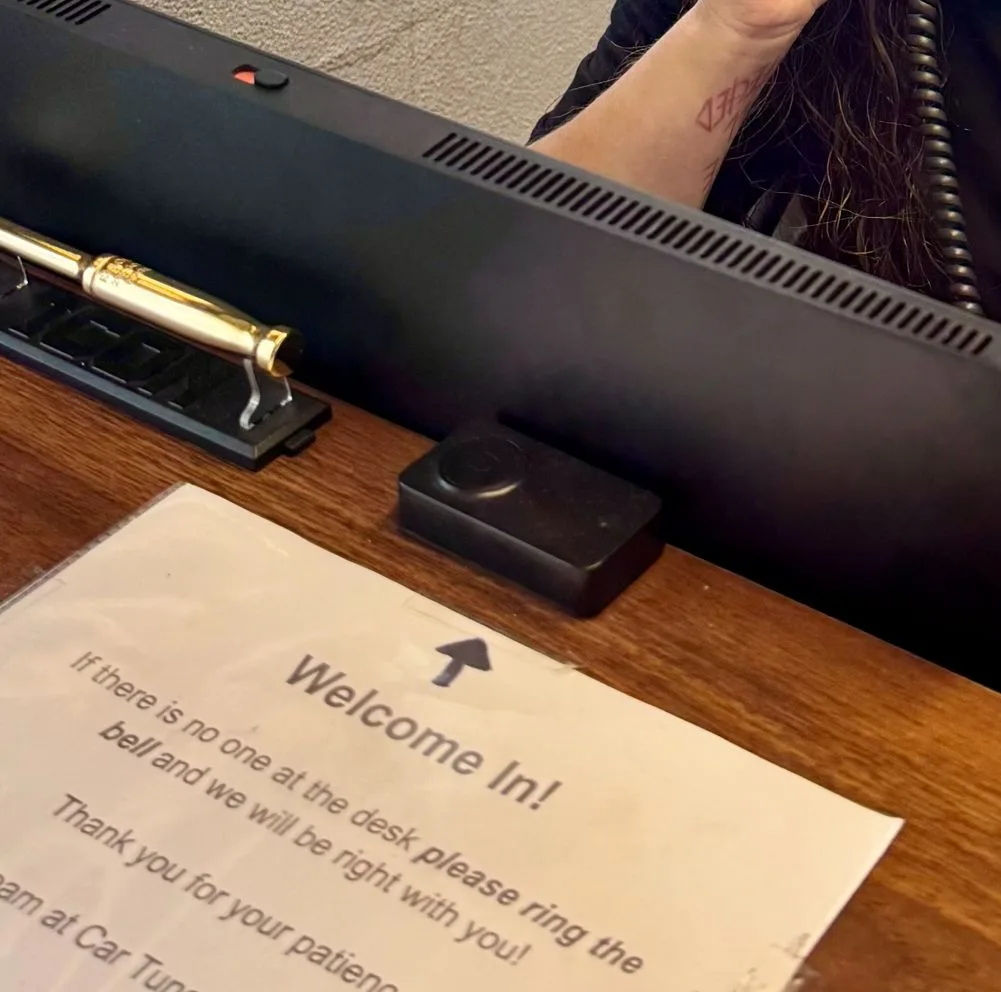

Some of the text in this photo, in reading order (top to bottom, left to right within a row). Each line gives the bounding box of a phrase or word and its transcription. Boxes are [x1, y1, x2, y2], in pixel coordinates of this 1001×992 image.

[286, 653, 563, 811] Welcome In!
[52, 793, 136, 856] Thank
[124, 845, 188, 883] you
[183, 872, 230, 905] for
[217, 897, 295, 940] your
[69, 650, 645, 975] If there is no one at the desk please ring the
[97, 720, 534, 967] bell and we will be right with you!
[40, 908, 81, 936] at
[74, 924, 132, 965] Car
[129, 953, 200, 992] Tun
